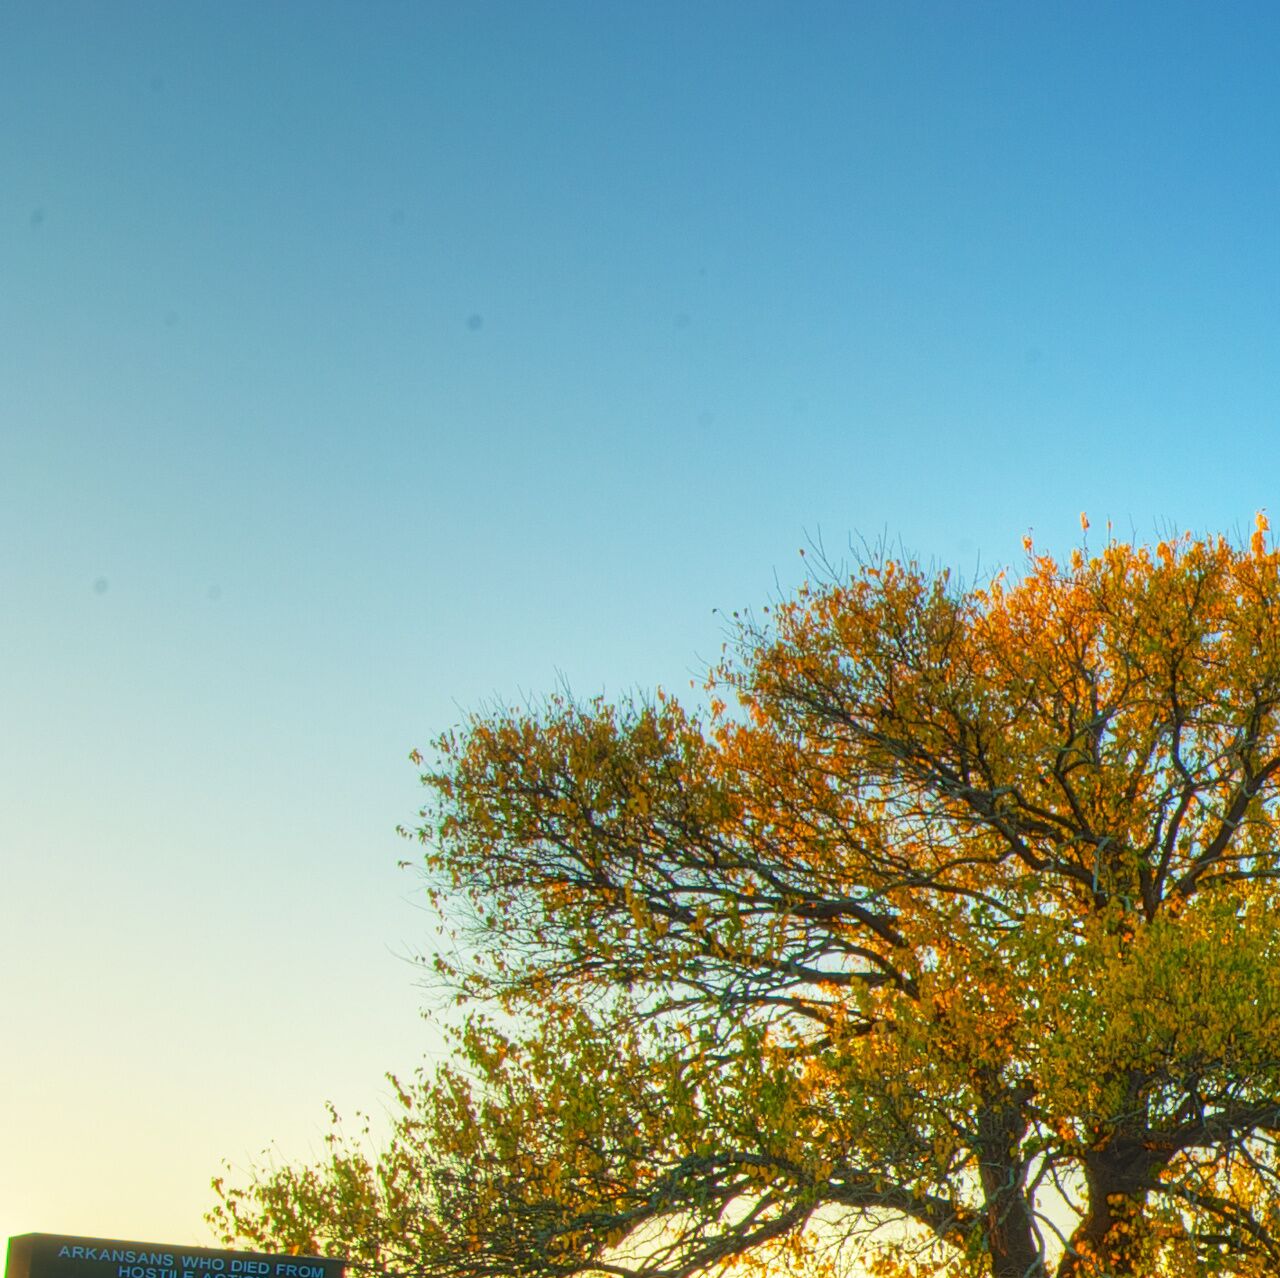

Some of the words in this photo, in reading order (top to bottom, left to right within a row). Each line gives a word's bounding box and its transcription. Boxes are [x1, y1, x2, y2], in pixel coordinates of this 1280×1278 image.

[59, 1246, 173, 1267] ARKANSANS
[181, 1256, 224, 1271] WHO
[230, 1260, 269, 1275] DIED
[275, 1264, 325, 1278] FROM
